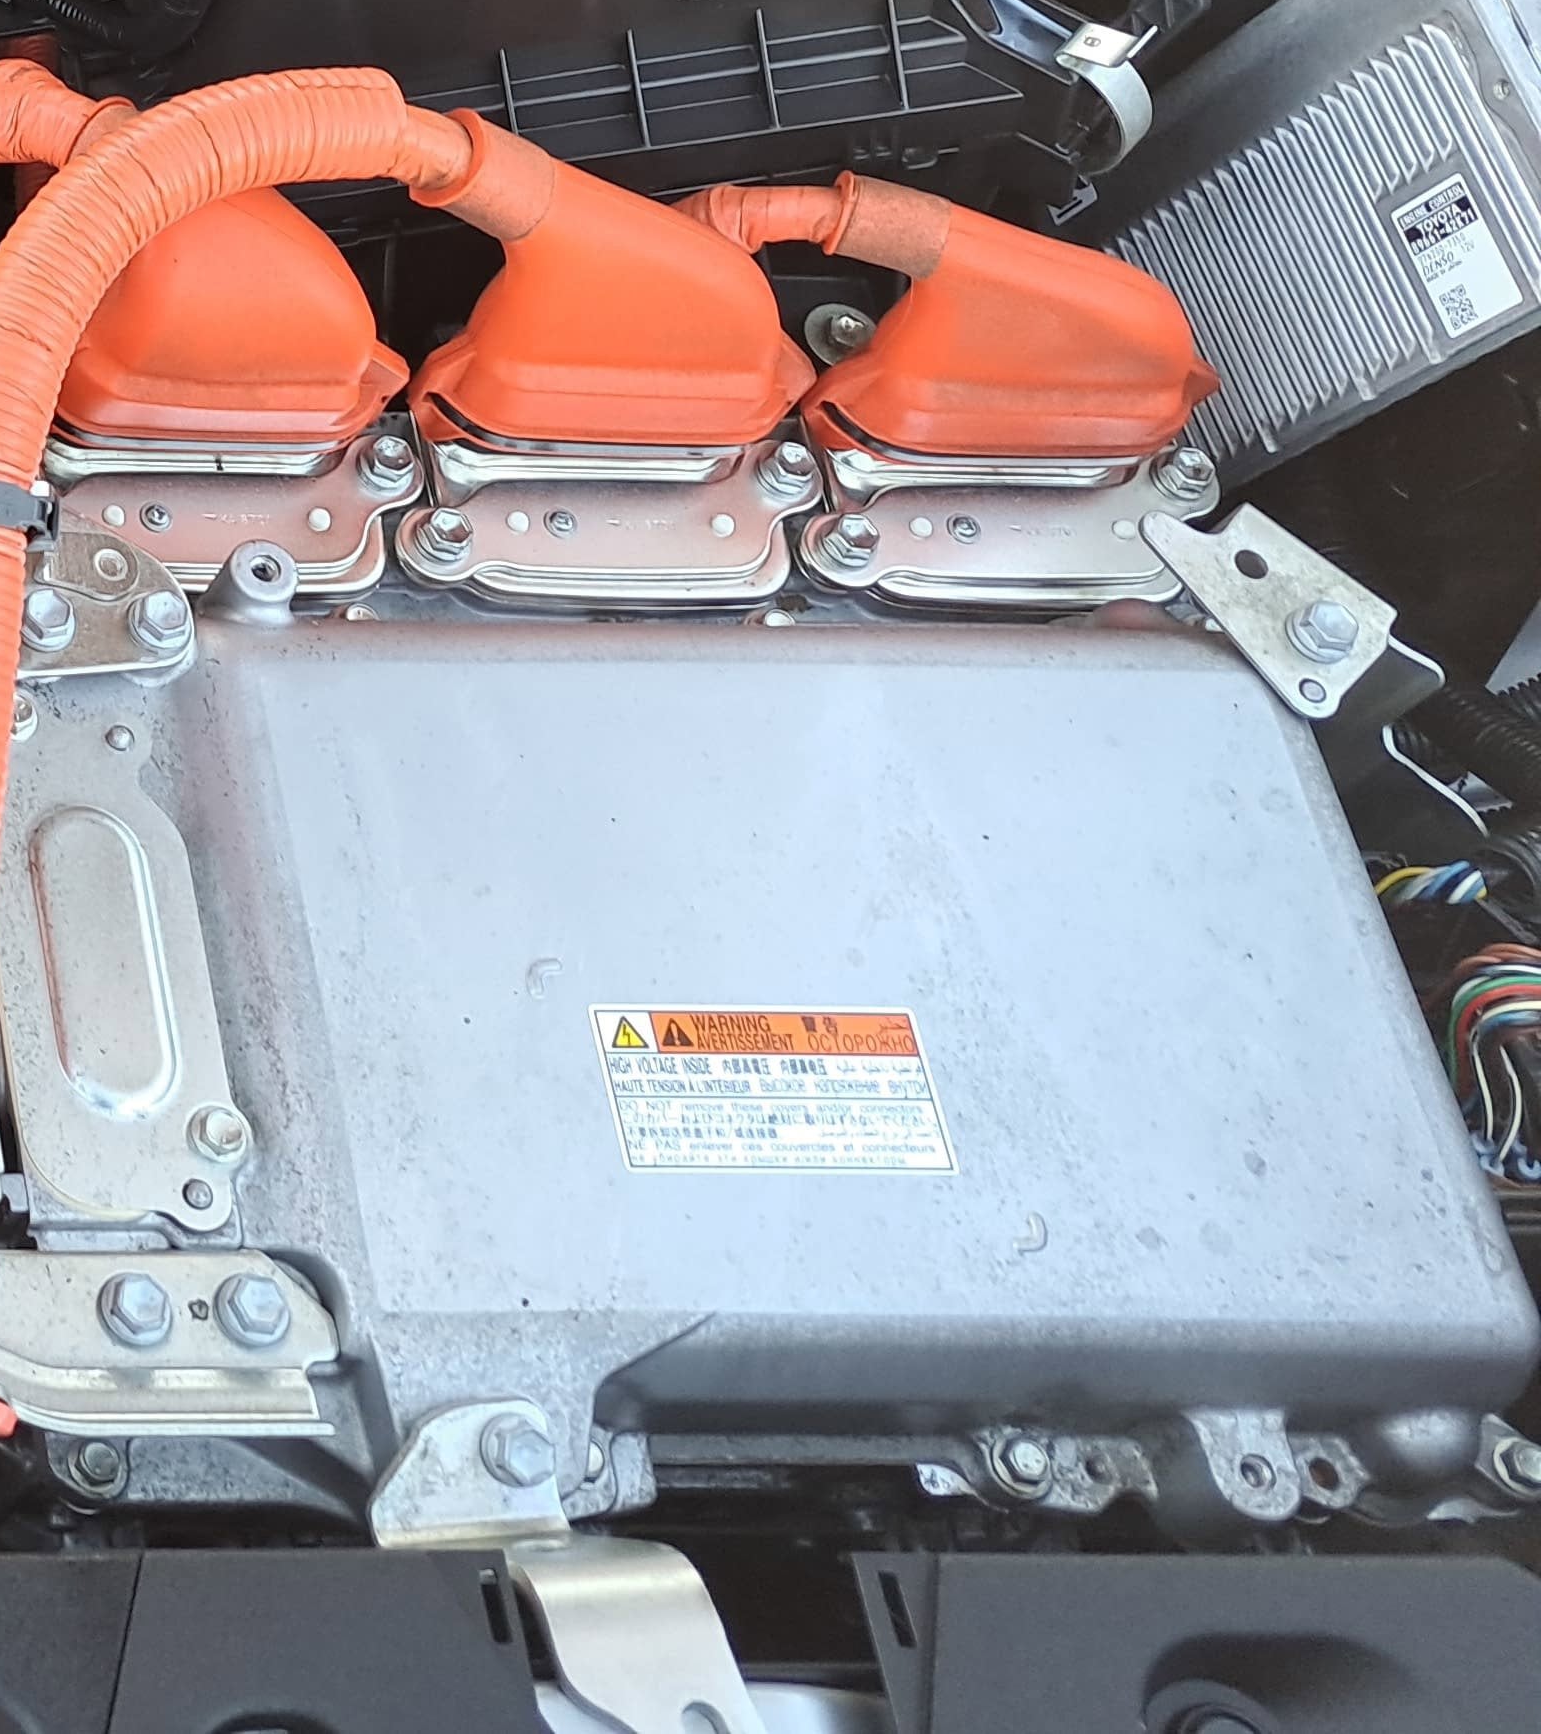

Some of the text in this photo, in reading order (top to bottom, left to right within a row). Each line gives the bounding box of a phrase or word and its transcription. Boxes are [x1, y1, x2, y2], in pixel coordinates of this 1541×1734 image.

[1415, 202, 1462, 236] TOYOTA
[1421, 250, 1455, 278] DENSO
[690, 1014, 772, 1033] WARNING
[695, 1033, 795, 1051] AVERTISSEMENT
[609, 1057, 713, 1075] HIGH VOLTAGE INSIDE
[614, 1079, 645, 1093] HAUTE
[647, 1079, 687, 1093] TENSION
[619, 1100, 638, 1111] DO
[645, 1100, 672, 1112] NOT
[655, 1139, 681, 1151] PAS
